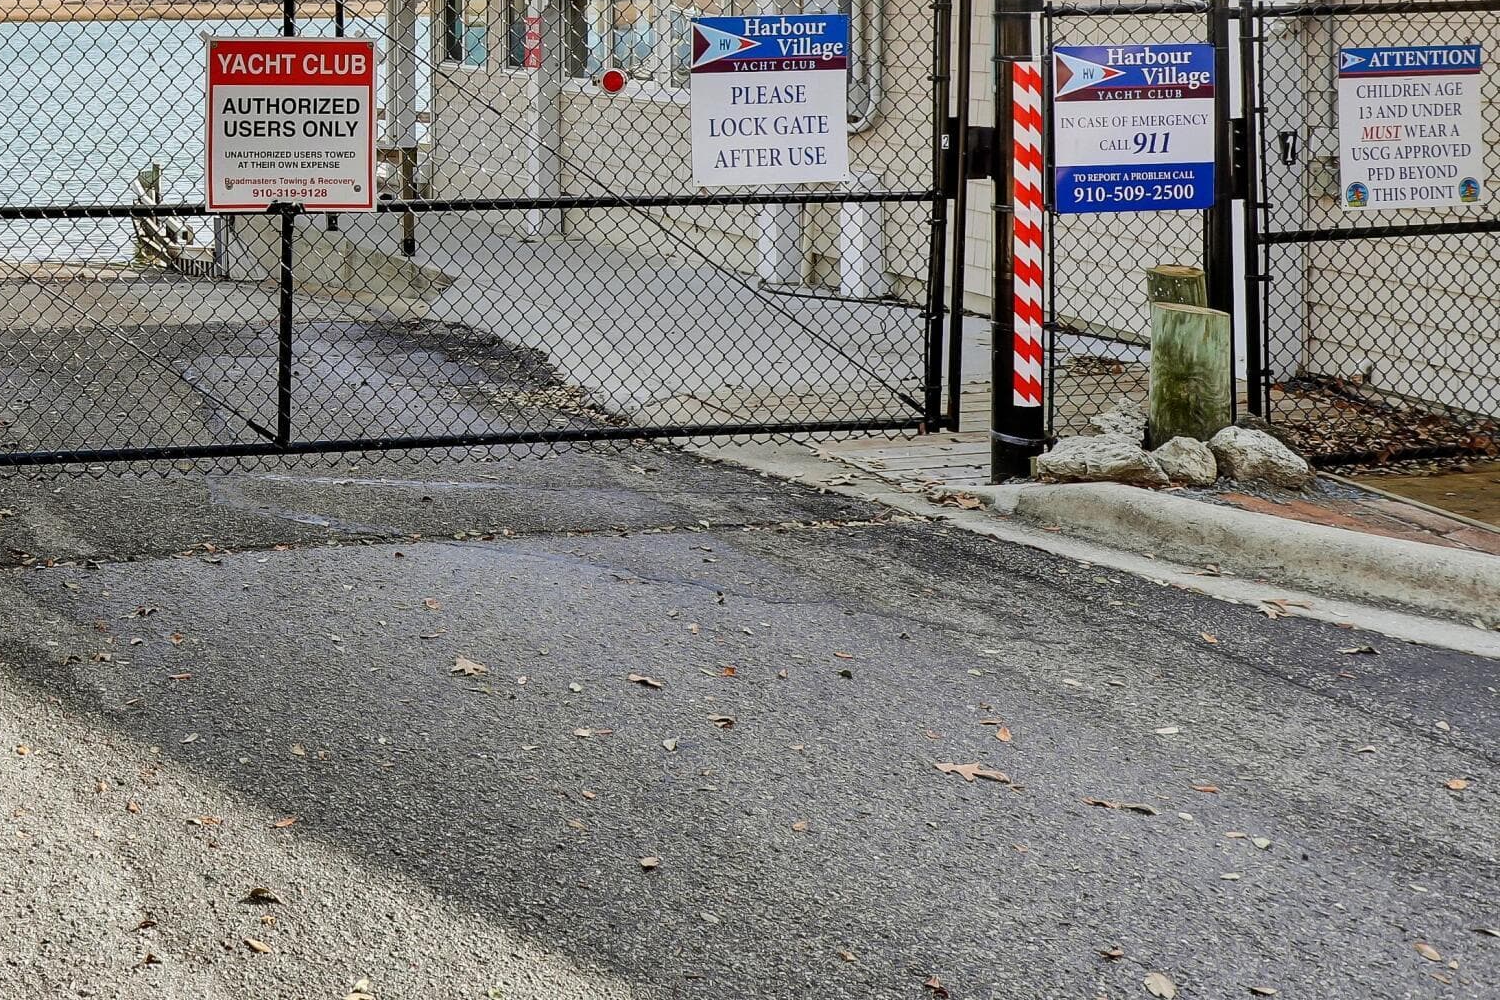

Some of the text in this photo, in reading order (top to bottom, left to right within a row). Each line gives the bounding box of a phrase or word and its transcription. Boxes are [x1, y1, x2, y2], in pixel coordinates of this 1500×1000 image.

[743, 18, 826, 36] Harbour
[719, 39, 731, 50] HV
[777, 37, 843, 60] Village
[218, 54, 366, 75] YACHT CLUB
[1107, 48, 1192, 65] Harbour
[1369, 49, 1476, 67] ATTENTION
[733, 61, 816, 71] YACHT CLUB
[1083, 69, 1094, 79] HV
[1141, 67, 1210, 88] Village
[731, 85, 807, 105] PLEASE
[1097, 90, 1182, 100] YACHT CLUB
[1356, 82, 1463, 98] CHILDREN AGE
[222, 98, 360, 114] AUTHORIZED
[1358, 103, 1462, 119] 13 AND UNDER
[224, 121, 358, 137] USERS ONLY
[709, 115, 829, 137] LOCK GATE
[1061, 114, 1208, 128] IN CASE OF EMERGENCY
[1361, 124, 1460, 139] MUST WEAR A
[943, 136, 948, 147] 2
[1100, 132, 1170, 154] CALL 911
[1286, 136, 1294, 161] 1
[714, 146, 827, 168] AFTER USE
[1351, 143, 1471, 161] USCG APPROVED
[1088, 173, 1121, 181] REPORT
[1131, 172, 1171, 180] PROBLEM
[1172, 171, 1194, 179] CALL
[1368, 165, 1457, 181] PFD BEYOND
[280, 178, 307, 186] Towing
[318, 178, 355, 186] Recovery
[253, 189, 327, 197] 910-319-9128
[1073, 184, 1194, 203] 910-509-2500
[1373, 185, 1455, 201] THIS POINT
